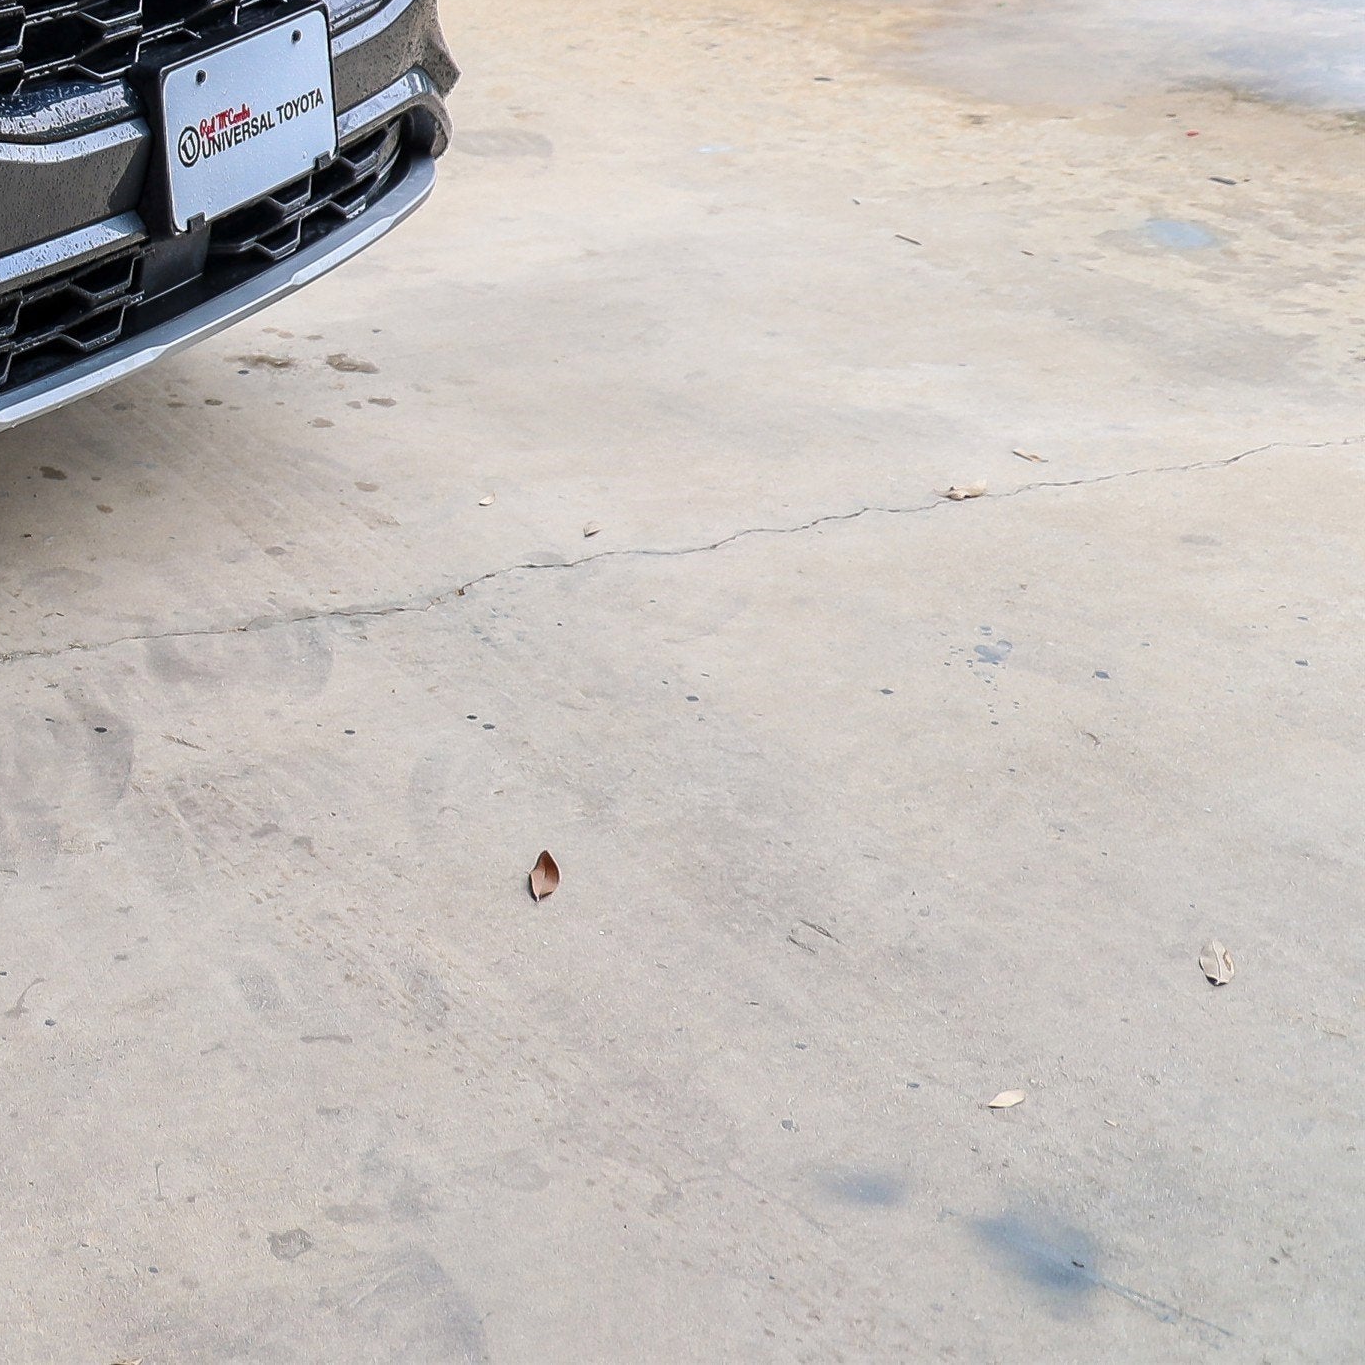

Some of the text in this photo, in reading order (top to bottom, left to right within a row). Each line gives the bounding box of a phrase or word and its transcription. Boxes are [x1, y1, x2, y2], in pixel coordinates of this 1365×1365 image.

[199, 117, 216, 138] Red
[201, 87, 324, 159] UNIVERSAL TOYOTA
